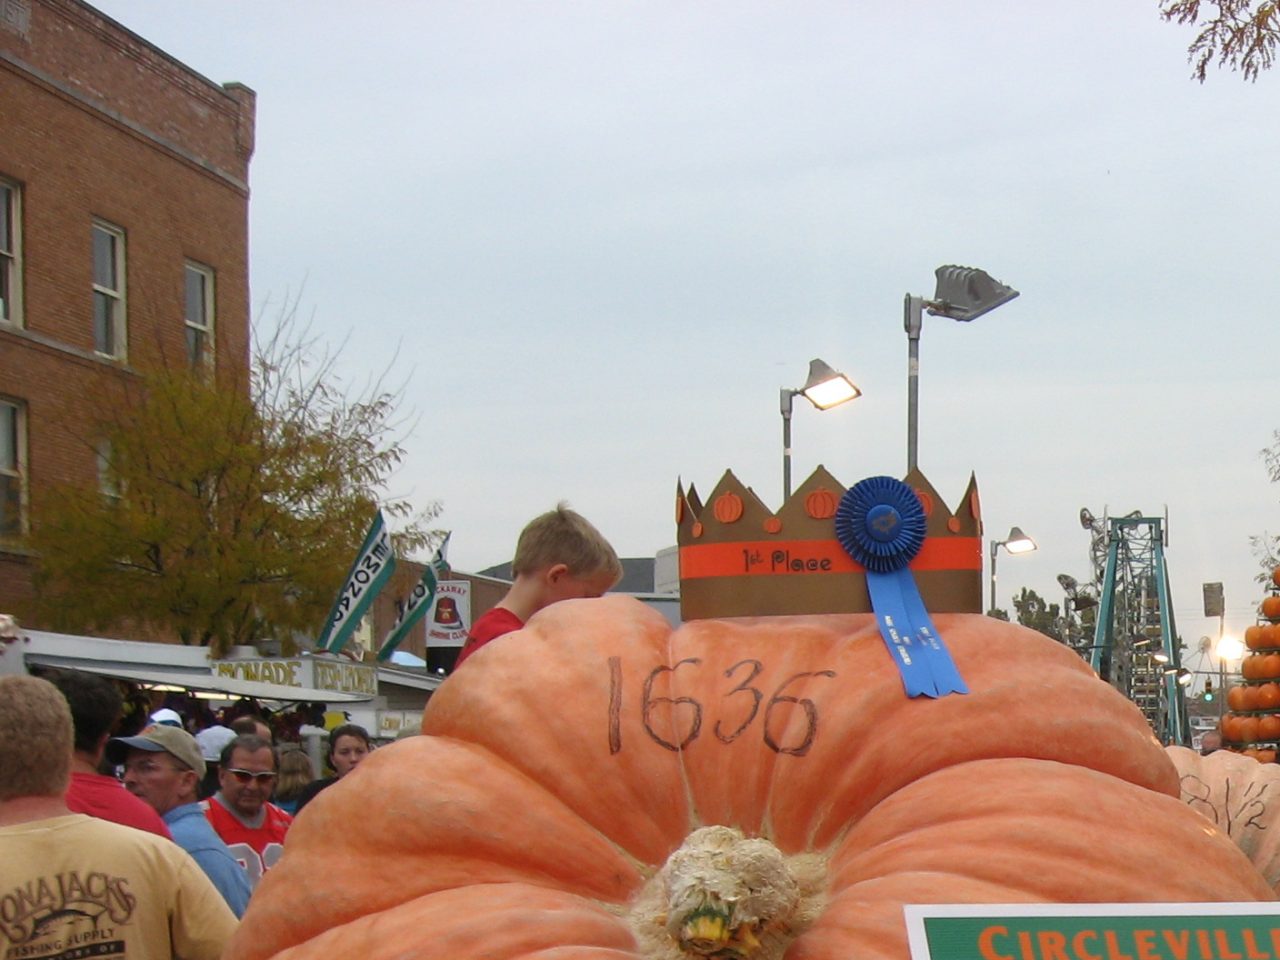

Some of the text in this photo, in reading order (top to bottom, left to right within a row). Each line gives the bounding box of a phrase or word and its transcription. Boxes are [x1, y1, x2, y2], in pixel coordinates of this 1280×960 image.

[742, 548, 833, 573] 1st Place
[331, 533, 388, 628] LEMONAD
[436, 584, 467, 595] CKAWAY
[217, 662, 302, 688] MONADE
[607, 655, 837, 758] 1636
[0, 877, 54, 936] ONA
[6, 928, 115, 958] FISHING SUPPLY
